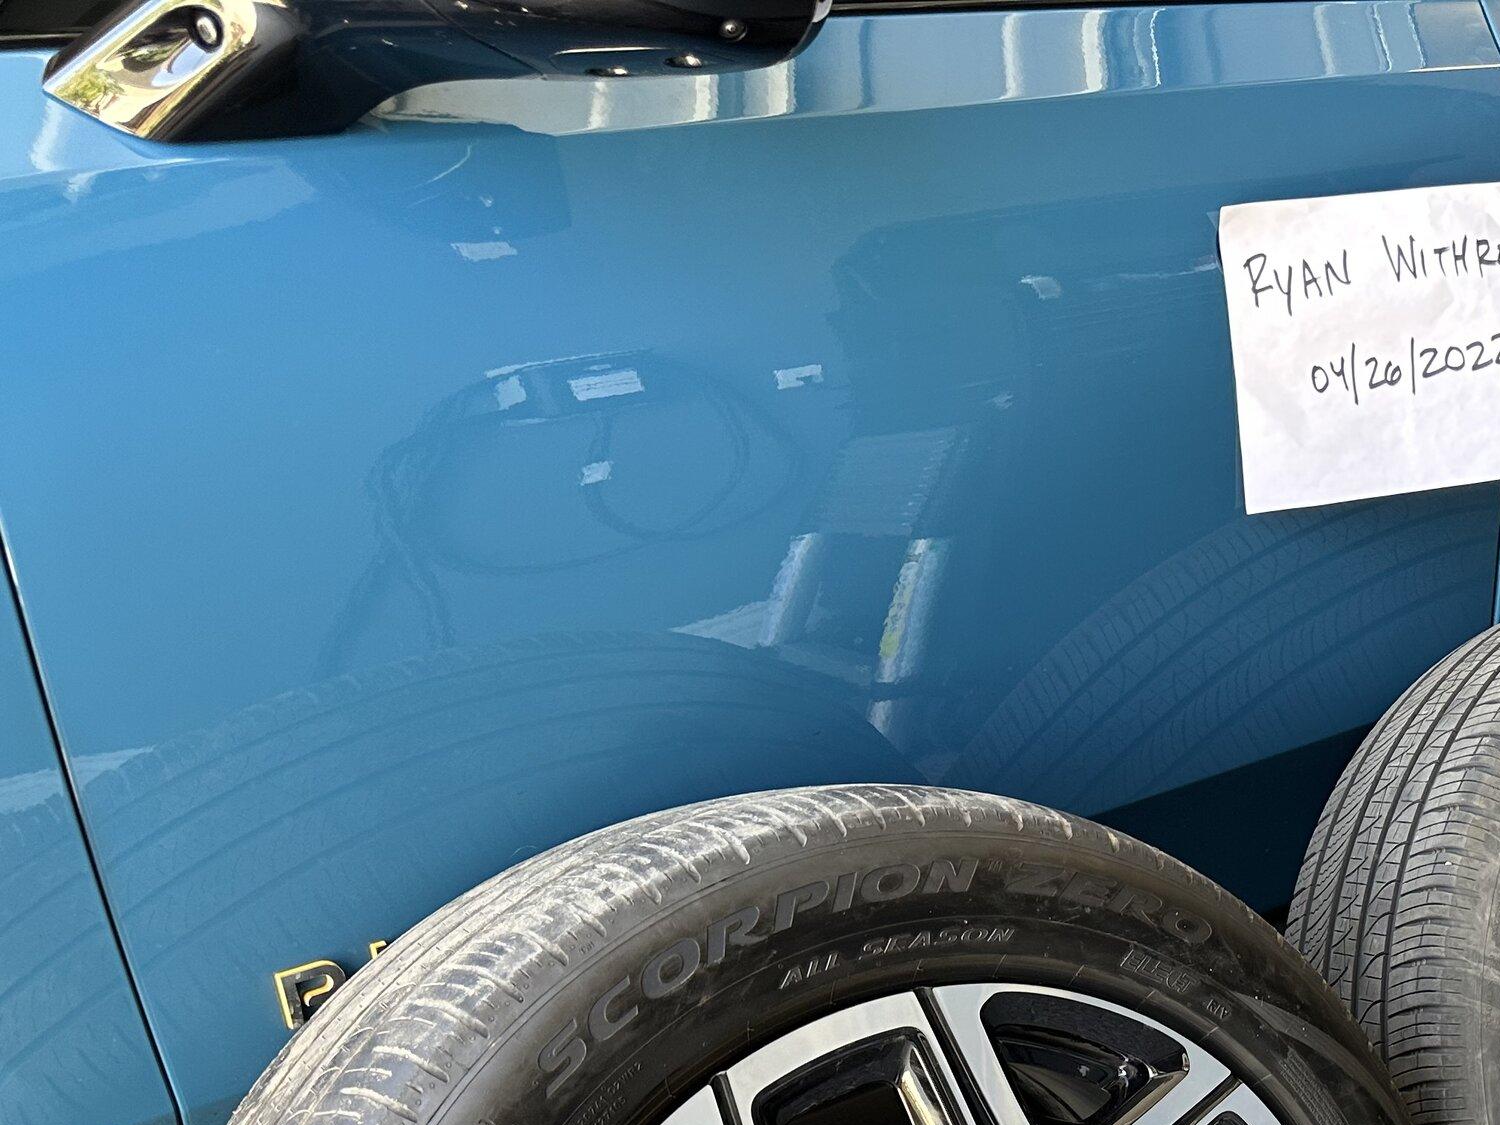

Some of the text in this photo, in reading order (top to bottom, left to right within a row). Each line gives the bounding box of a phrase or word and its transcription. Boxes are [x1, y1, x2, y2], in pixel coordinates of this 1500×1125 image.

[1243, 249, 1352, 317] RYAN
[539, 858, 1213, 1098] SCORPION ZERO
[778, 925, 1016, 991] ALL SEASON
